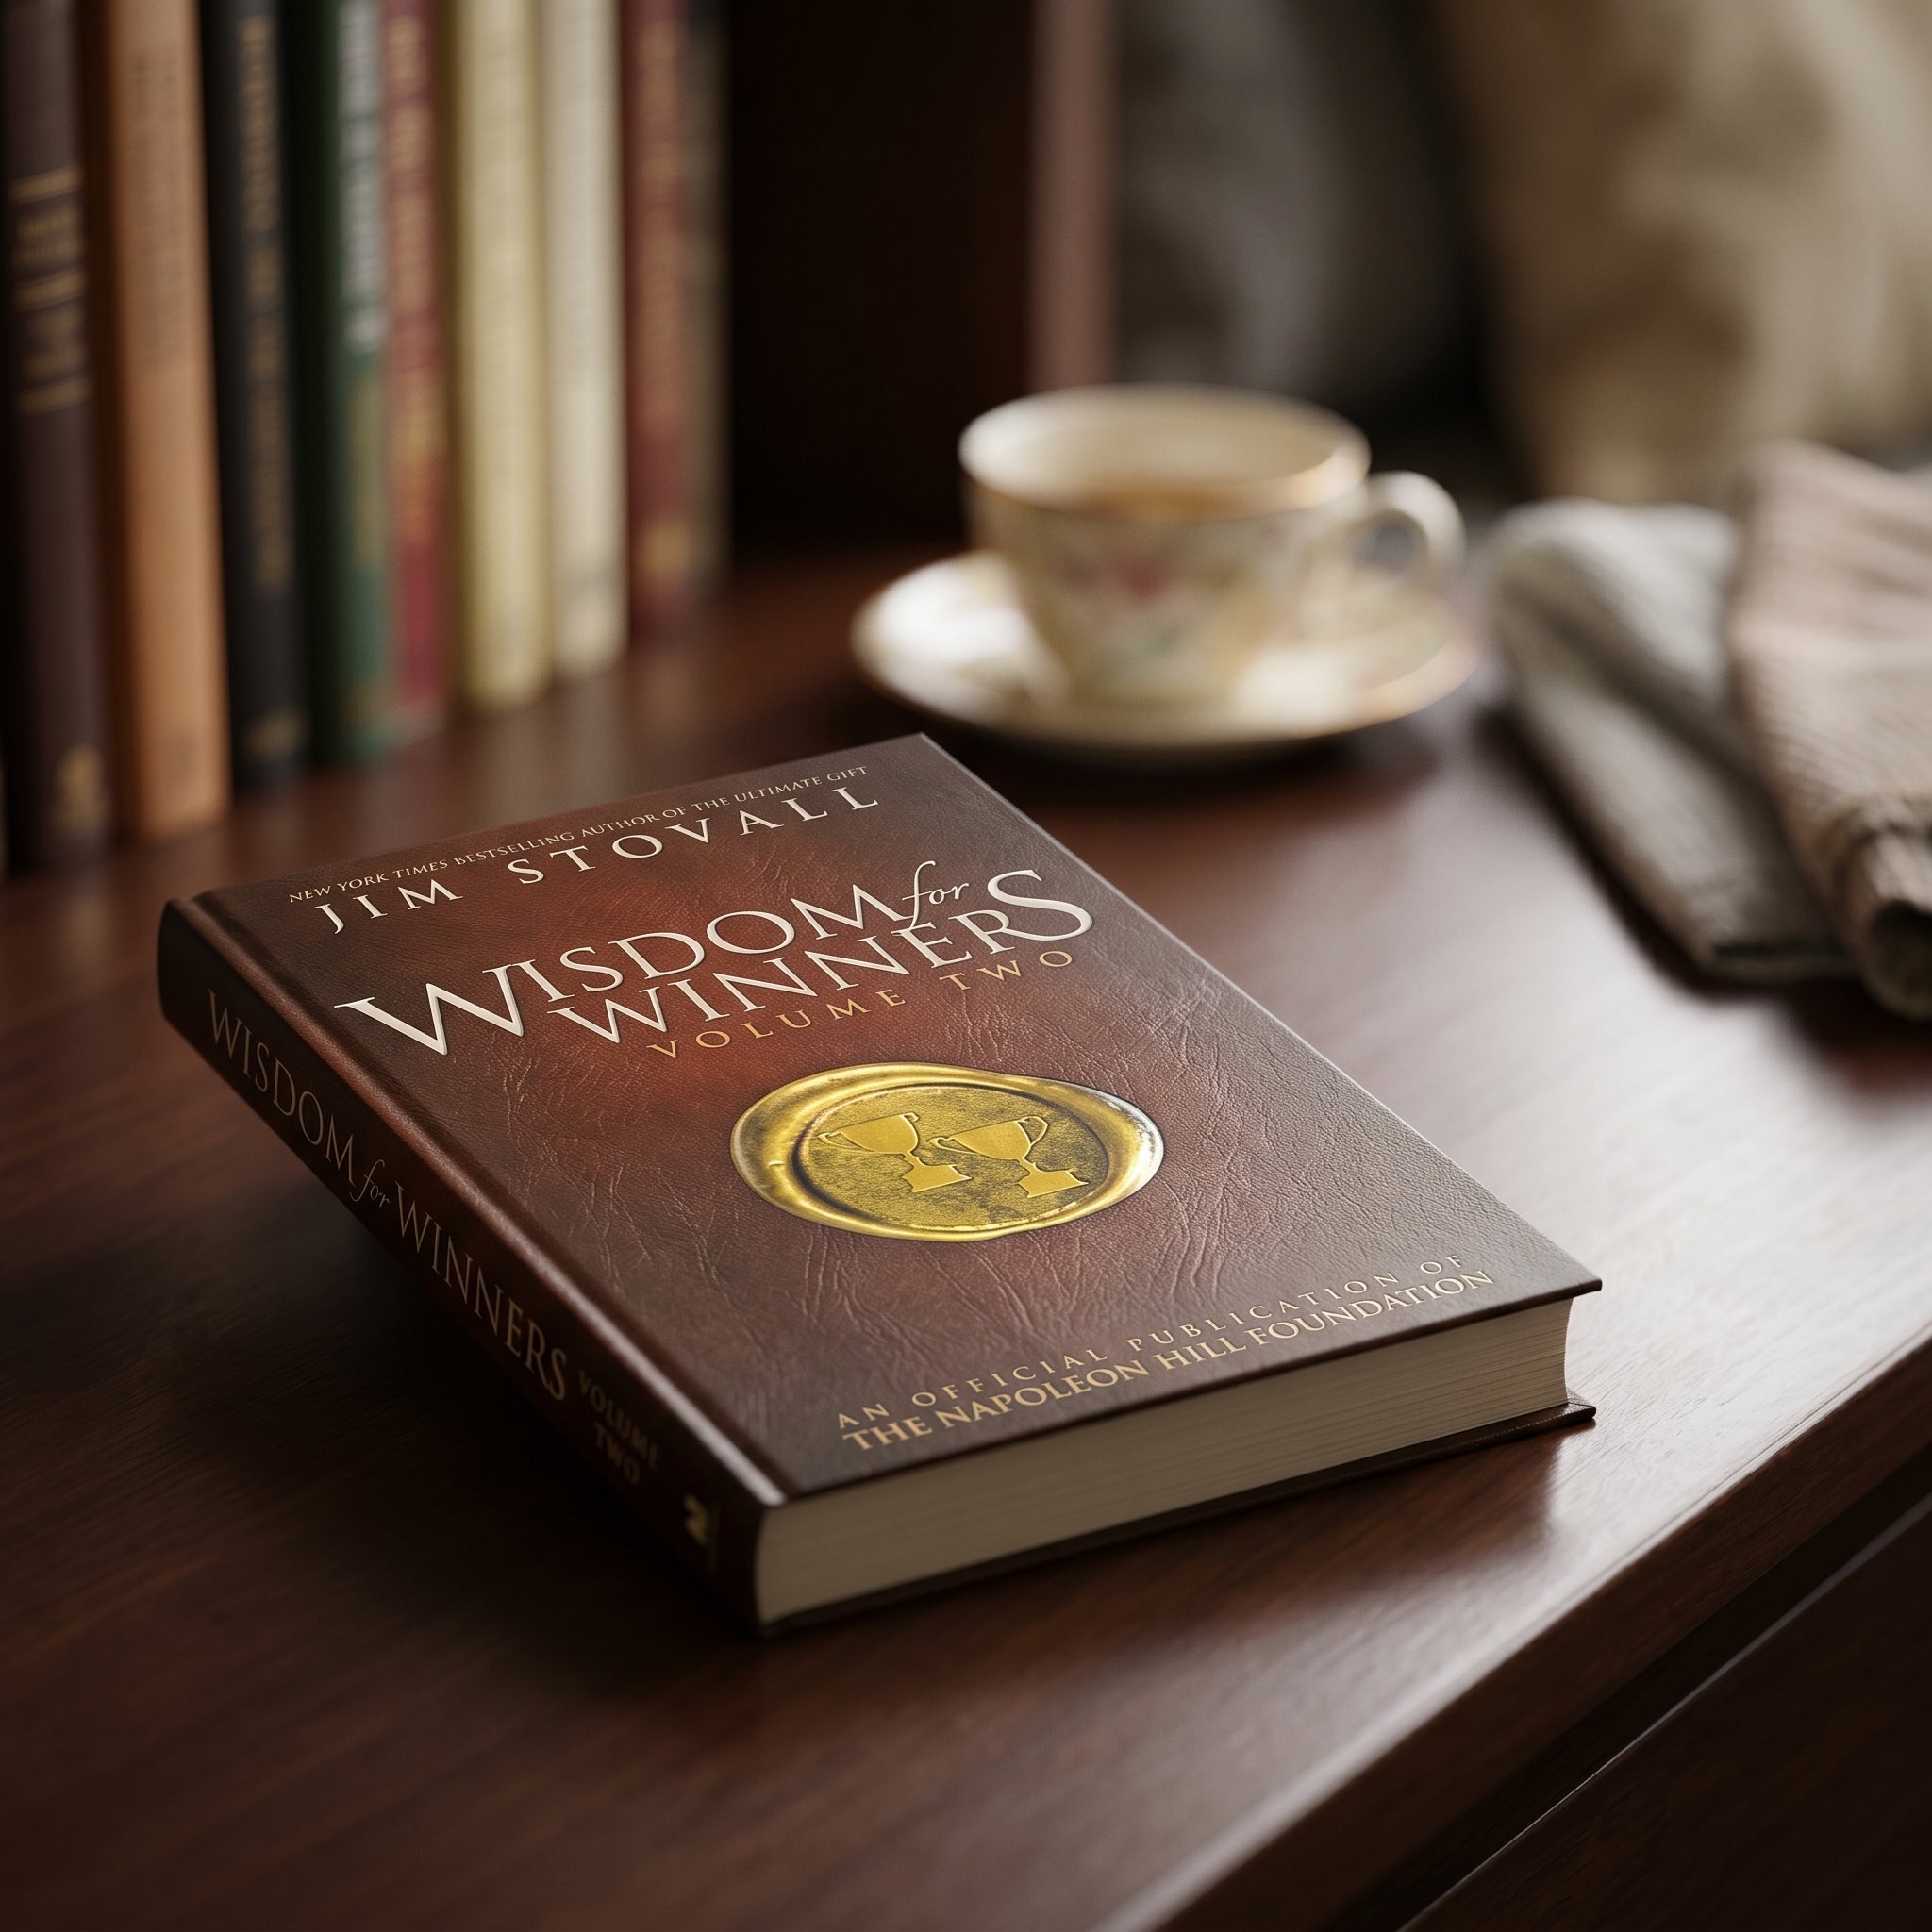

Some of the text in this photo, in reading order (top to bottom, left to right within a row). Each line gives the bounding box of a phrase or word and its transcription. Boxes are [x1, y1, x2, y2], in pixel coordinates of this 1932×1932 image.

[290, 766, 867, 903] NEW YORK TIMES BESTSELLING AUTHOR OF THE ULTIMATE GIFT
[315, 786, 878, 934] JIM STOVALL
[334, 860, 969, 1055] WISDOM for
[547, 870, 1092, 1043] WINNERS
[646, 950, 1073, 1058] VOLUME TWO
[208, 989, 566, 1402] WISDOM for WINNERS
[837, 1255, 1462, 1429] AN OFFICIAL PUBLICATION OF
[842, 1271, 1493, 1451] THE NAPOLEON HILL FOUNDATION
[594, 1422, 641, 1485] TWO
